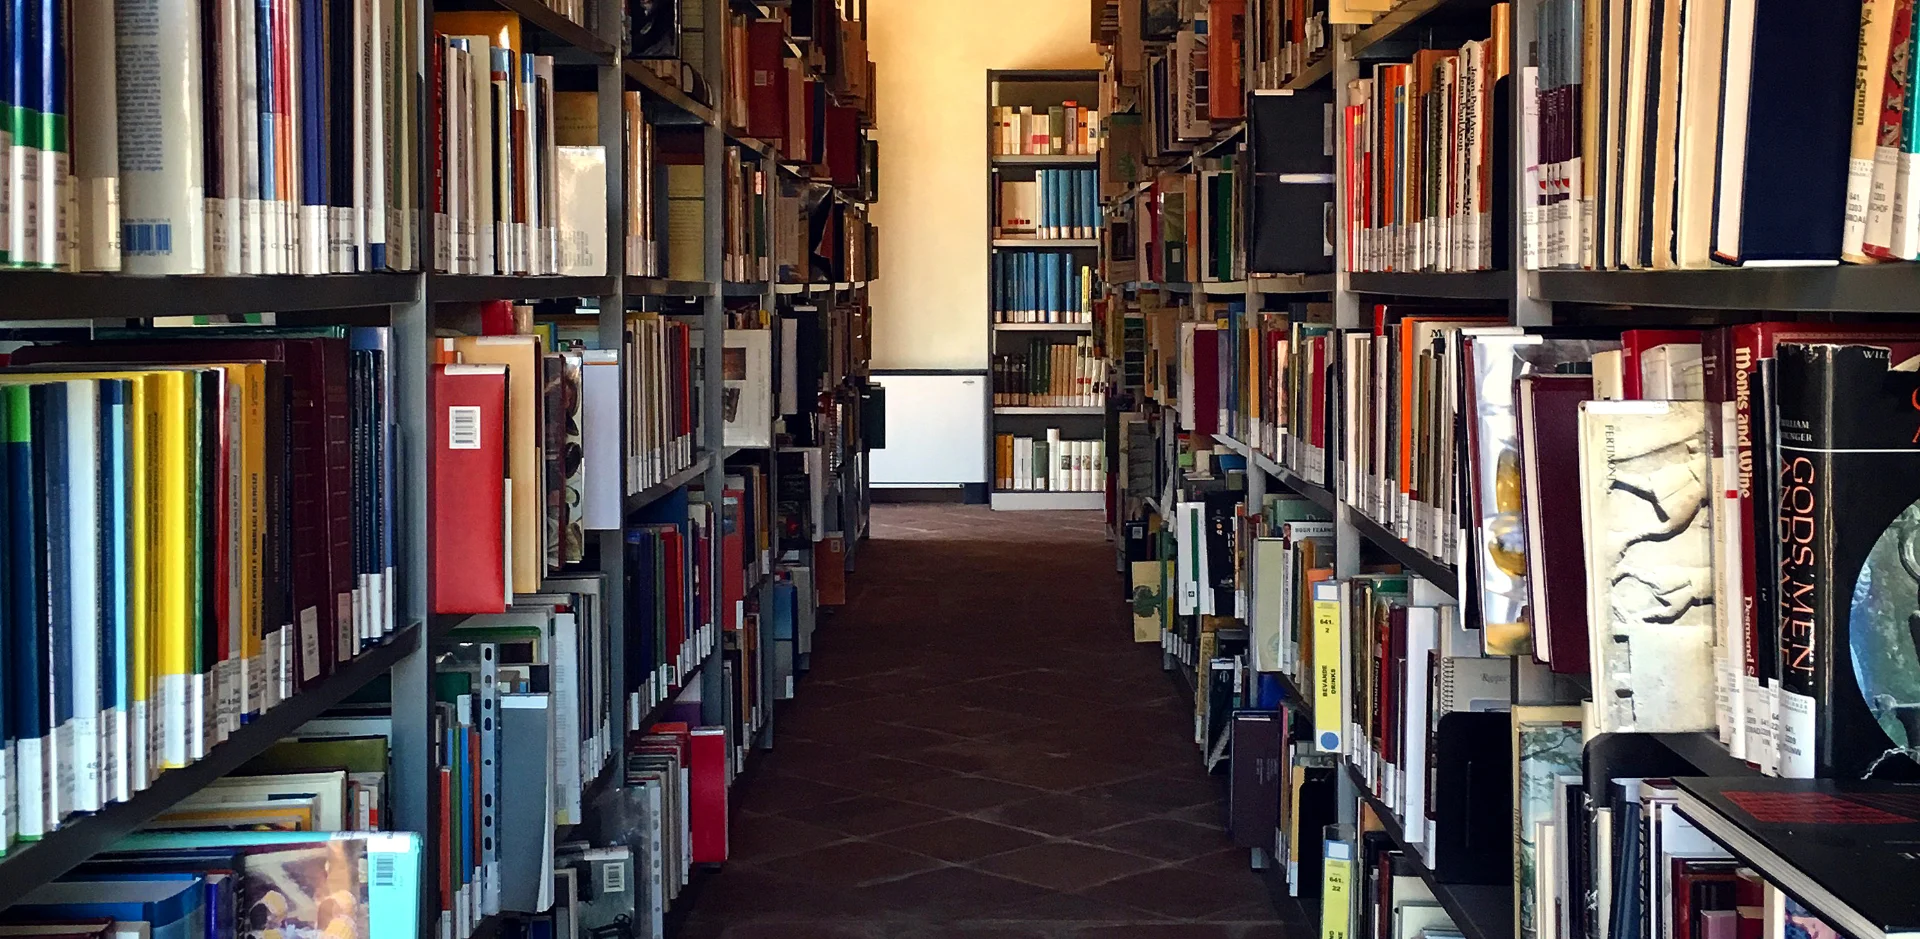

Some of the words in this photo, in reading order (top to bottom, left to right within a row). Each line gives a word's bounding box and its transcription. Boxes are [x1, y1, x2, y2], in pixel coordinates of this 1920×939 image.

[1470, 65, 1478, 119] Jean-Paul
[1457, 127, 1465, 152] Aron
[1469, 120, 1477, 146] Aron
[1734, 346, 1753, 415] Monks
[1736, 414, 1752, 447] and
[1738, 447, 1754, 500] Wine
[1744, 595, 1755, 664] Desmond
[1321, 664, 1329, 698] BEVANDE
